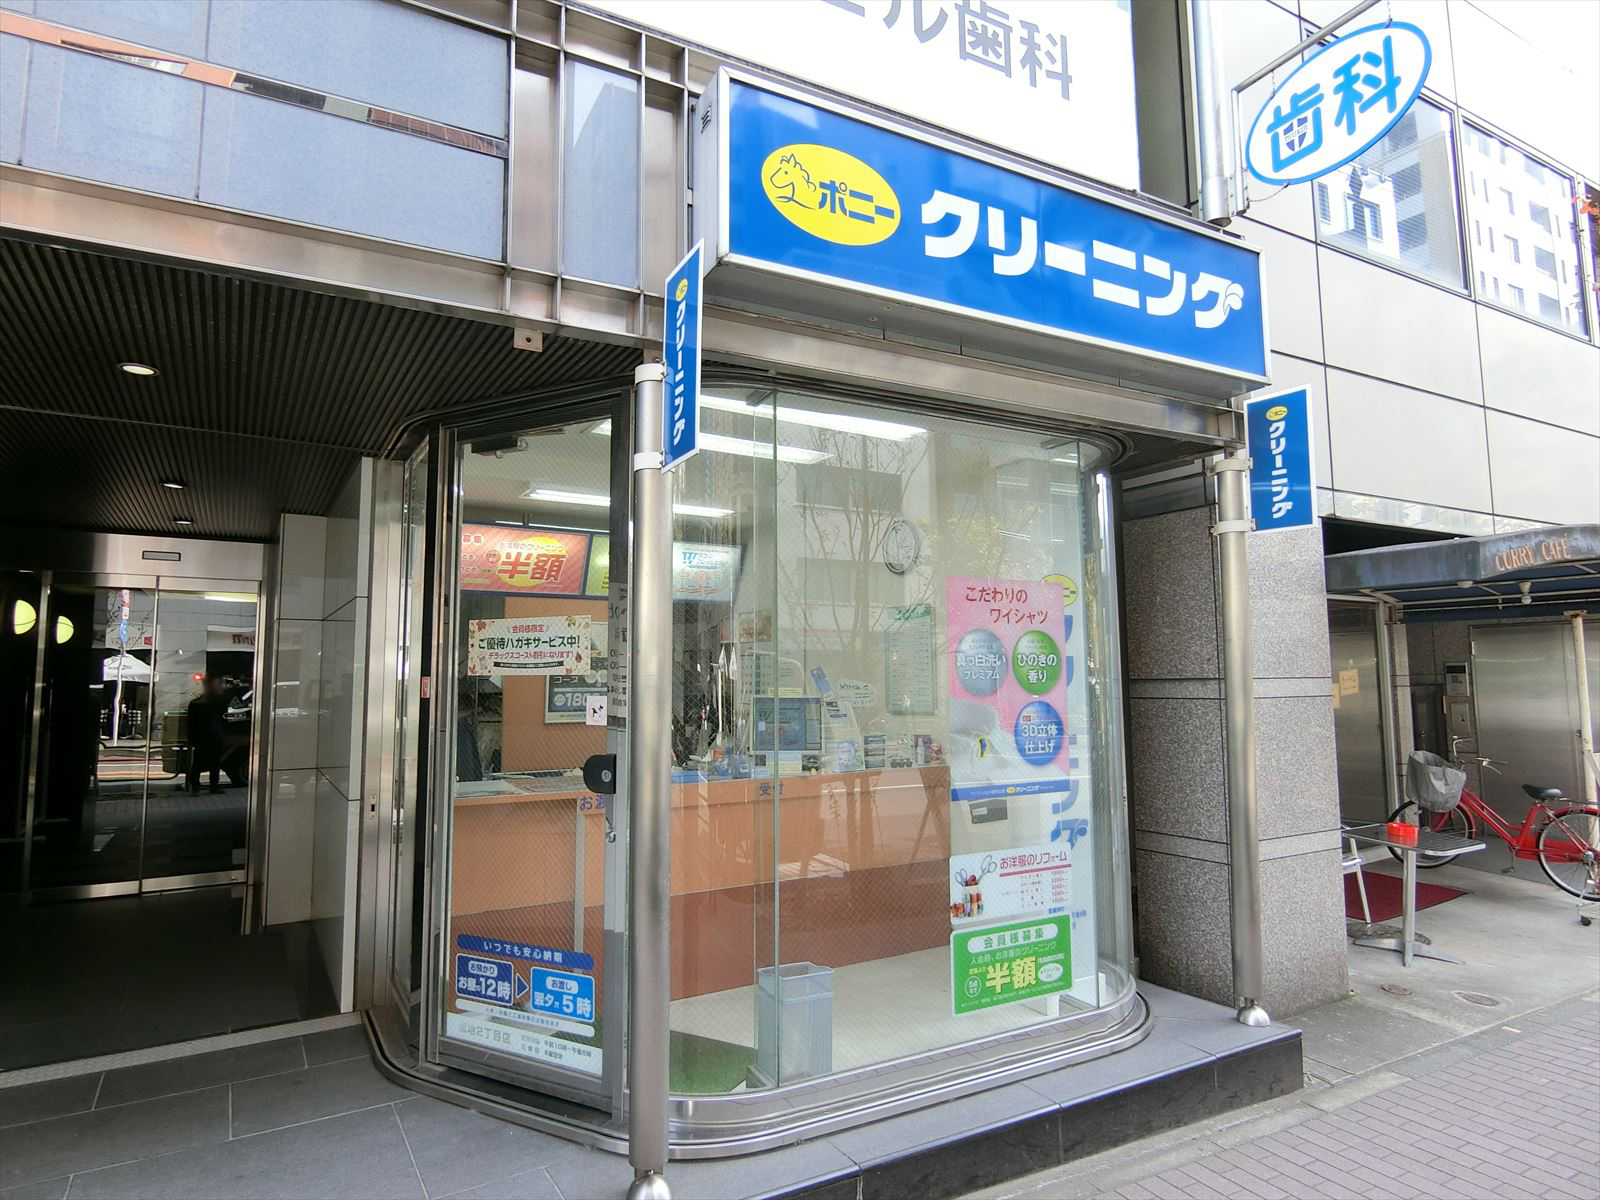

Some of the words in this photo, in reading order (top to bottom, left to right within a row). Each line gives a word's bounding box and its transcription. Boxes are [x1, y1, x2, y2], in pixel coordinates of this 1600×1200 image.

[1266, 35, 1402, 173] 歯科
[818, 180, 895, 224] ポニー
[920, 188, 1245, 329] クリーニング
[673, 299, 687, 447] クリーニング
[1269, 420, 1294, 519] クリーニング
[496, 551, 568, 583] 半額
[1495, 545, 1536, 571] CURRY
[965, 586, 1028, 603] こだわりの
[989, 608, 1048, 624] ワイシャツ
[956, 653, 1007, 667] 真っ白洗い
[1017, 653, 1057, 667] ひのきの
[963, 669, 1000, 680] プレミアム
[1027, 669, 1047, 683] 香り
[1021, 723, 1058, 737] 3D立体
[1024, 739, 1056, 754] 仕上げ
[1000, 851, 1068, 870] お洋服のリフォーム
[983, 927, 1044, 949] 会員様募集
[483, 941, 563, 963] いつでも安心納期
[985, 955, 1038, 994] 半額
